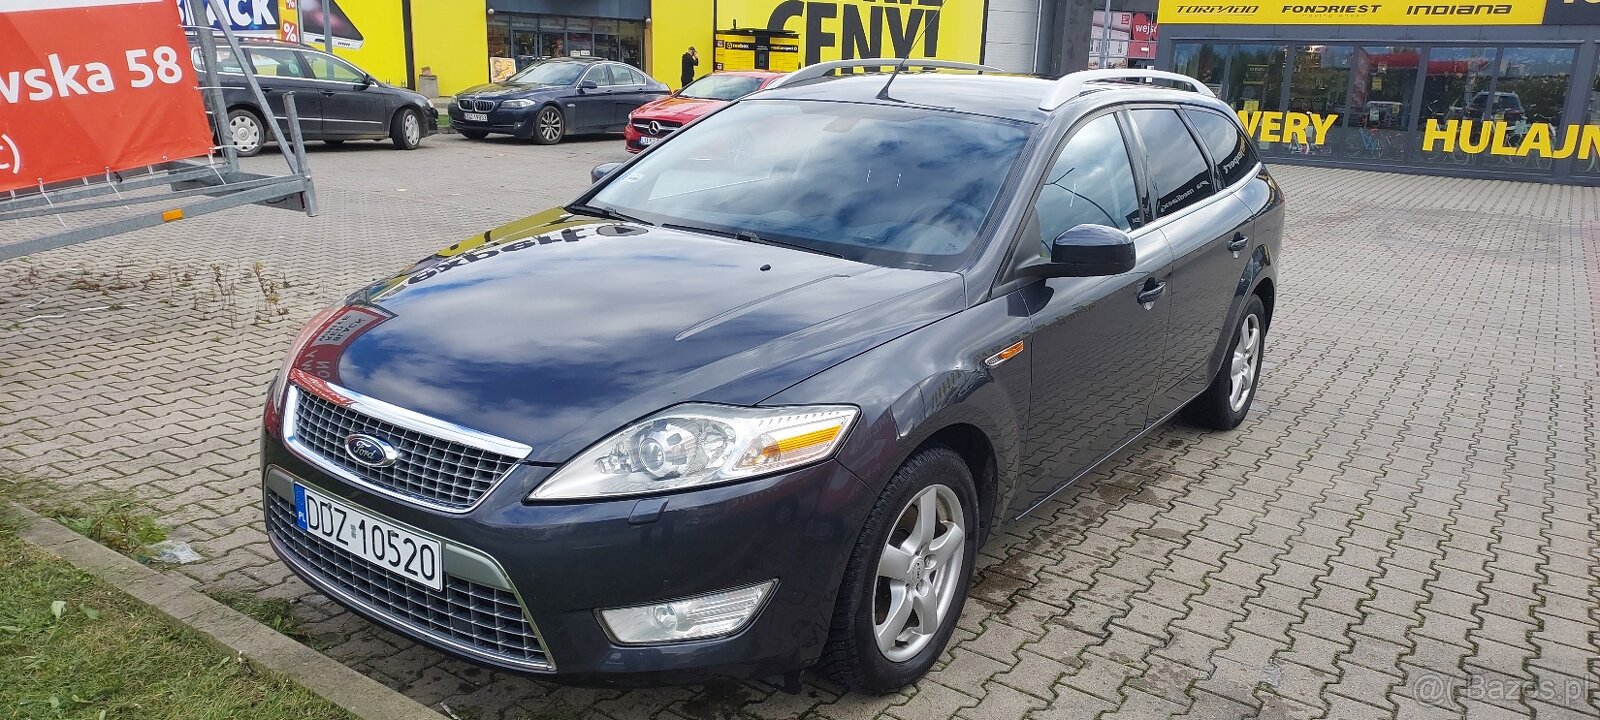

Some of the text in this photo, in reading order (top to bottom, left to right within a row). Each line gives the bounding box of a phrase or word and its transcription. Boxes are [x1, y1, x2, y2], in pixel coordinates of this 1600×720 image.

[1281, 4, 1382, 14] FONDRIEST
[125, 46, 183, 88] 58
[353, 440, 377, 459] Ford
[306, 494, 436, 582] DDZ 10520
